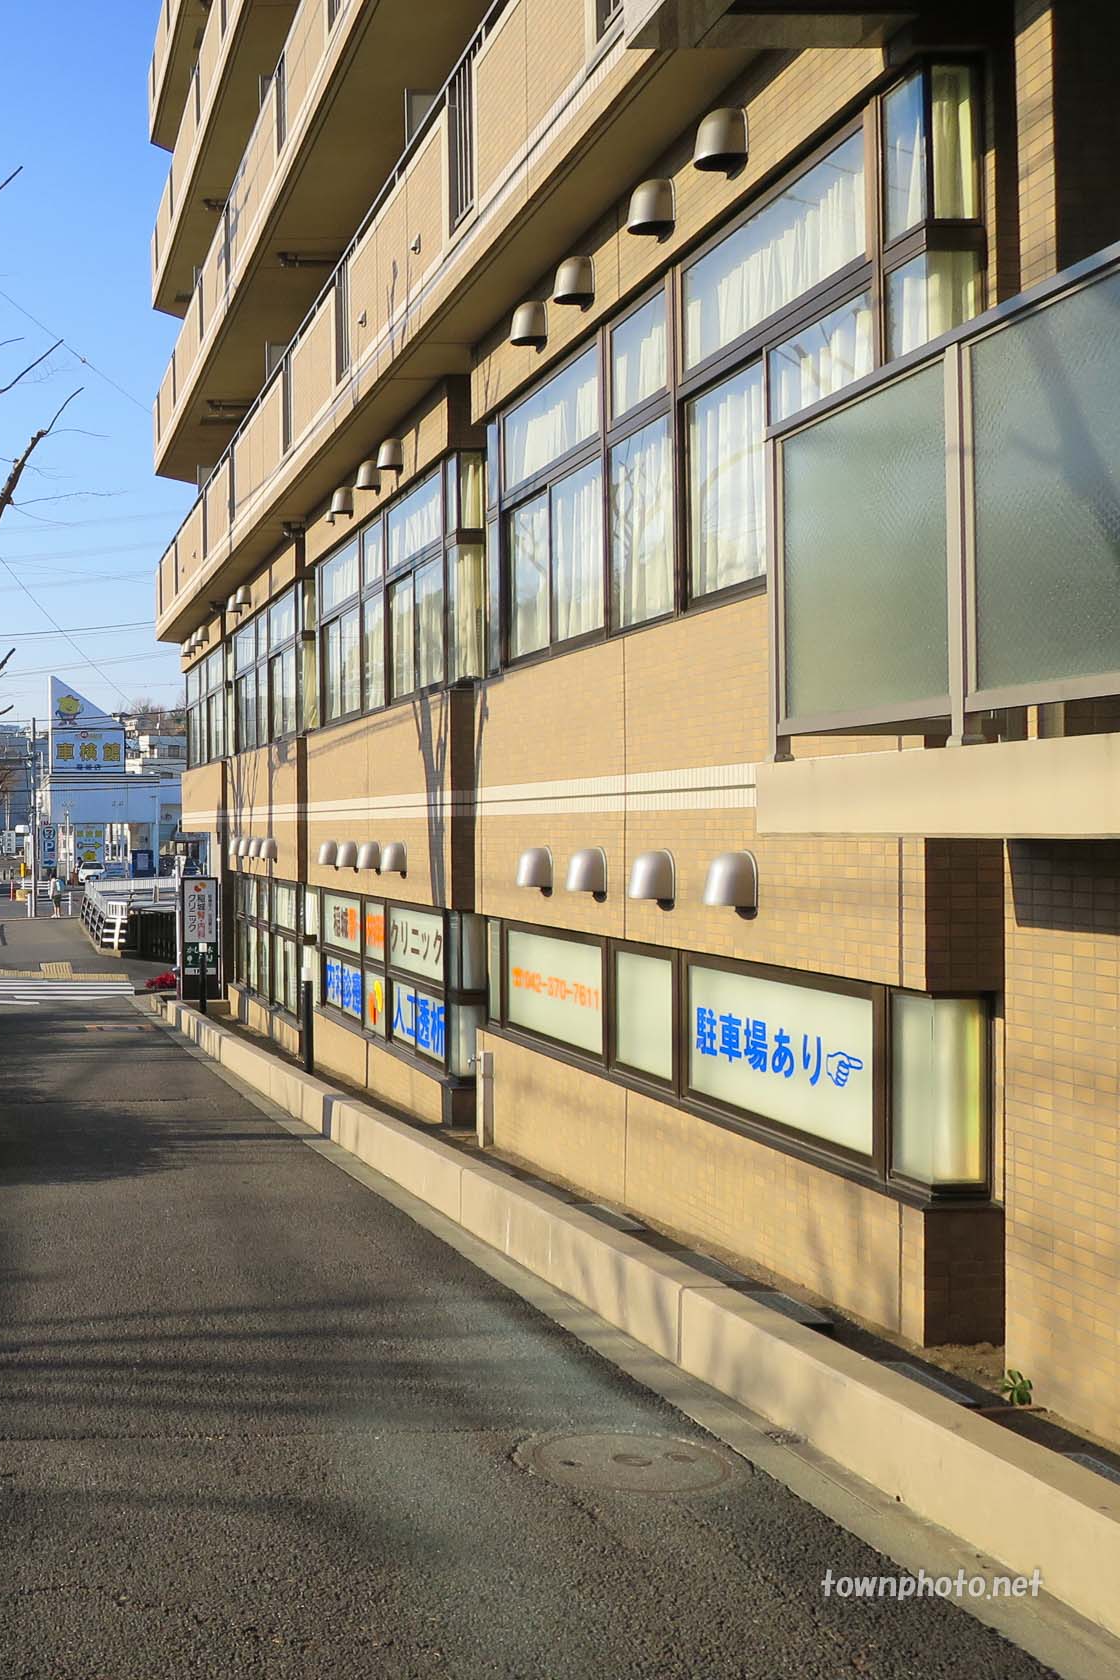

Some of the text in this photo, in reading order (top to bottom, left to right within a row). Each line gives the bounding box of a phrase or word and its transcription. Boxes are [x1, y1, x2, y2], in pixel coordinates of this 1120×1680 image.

[56, 743, 121, 761] 車検館
[188, 894, 197, 932] クリニック
[391, 919, 443, 965] クリニック
[696, 1007, 822, 1087] 駐車場あり
